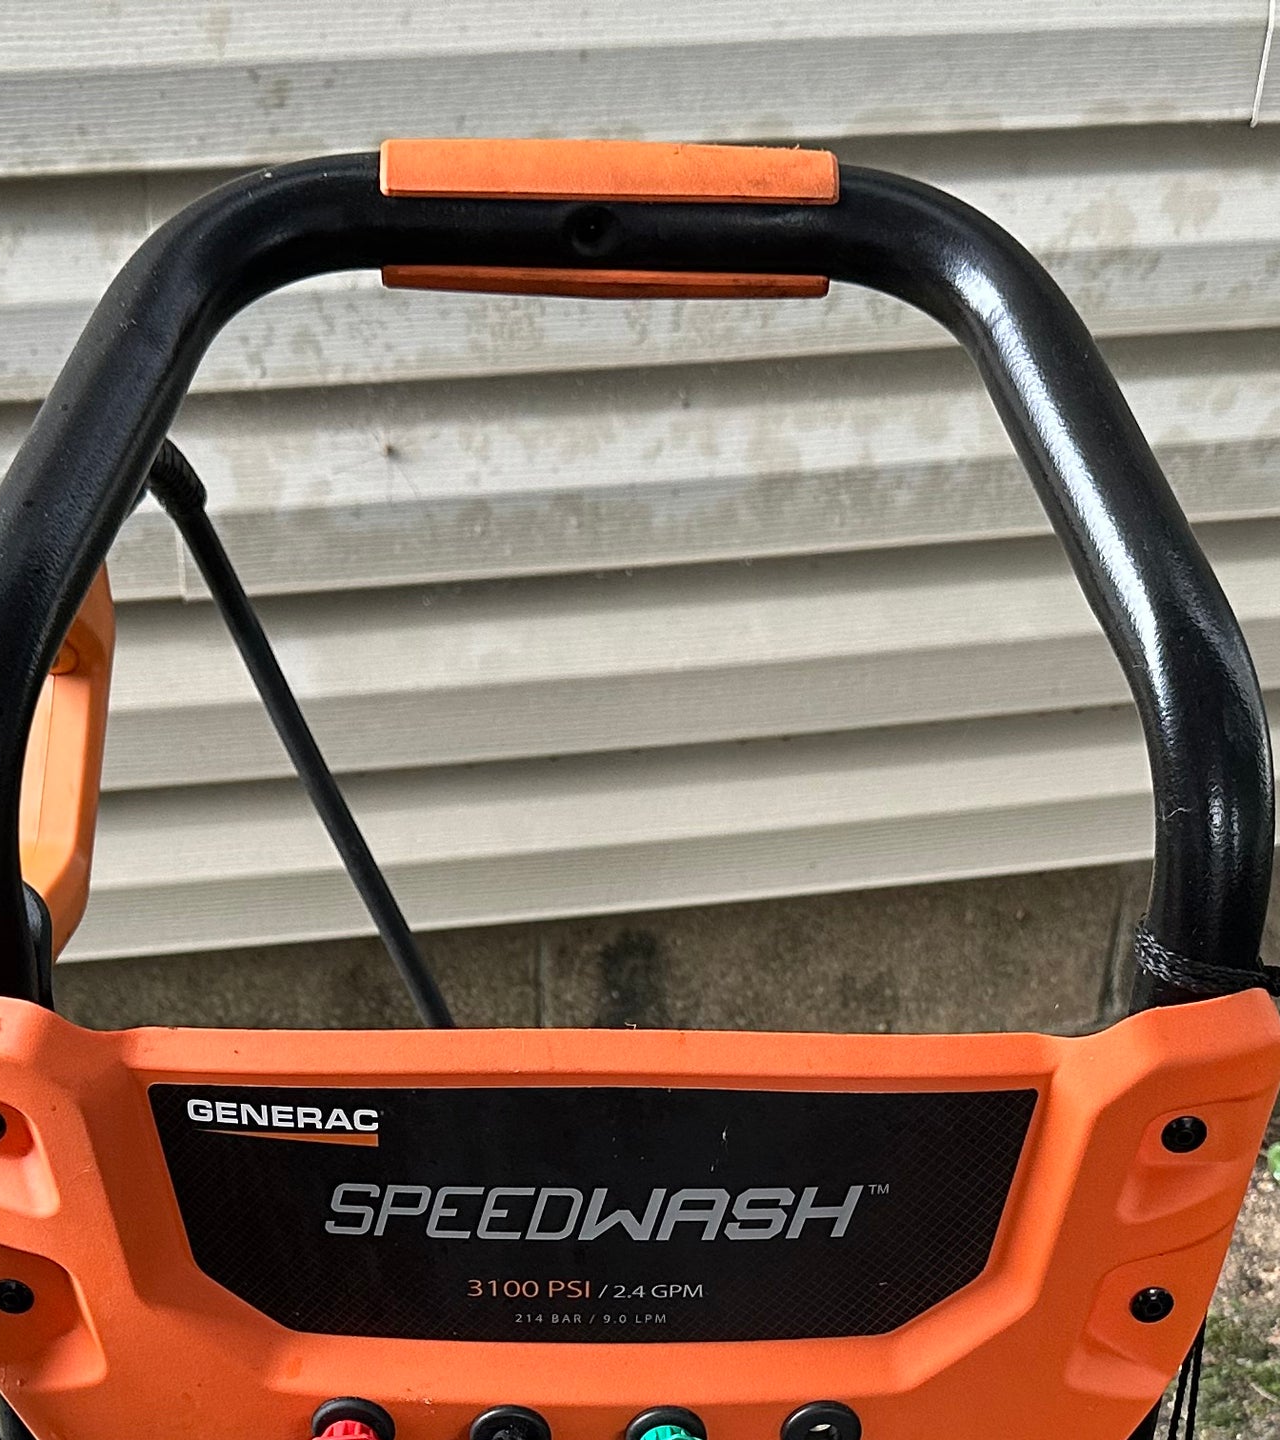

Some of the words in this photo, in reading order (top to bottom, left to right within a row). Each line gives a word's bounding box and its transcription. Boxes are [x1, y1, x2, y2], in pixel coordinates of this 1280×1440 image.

[187, 1099, 378, 1131] GENERAC
[324, 1183, 864, 1241] SPEEDWASH
[467, 1279, 539, 1298] 3100
[548, 1280, 590, 1298] PSI
[613, 1284, 645, 1299] 2.4
[651, 1284, 704, 1299] GPM
[515, 1313, 543, 1324] 214
[551, 1313, 582, 1324] BAR
[603, 1313, 627, 1324] 9.0
[635, 1313, 667, 1324] LPM
